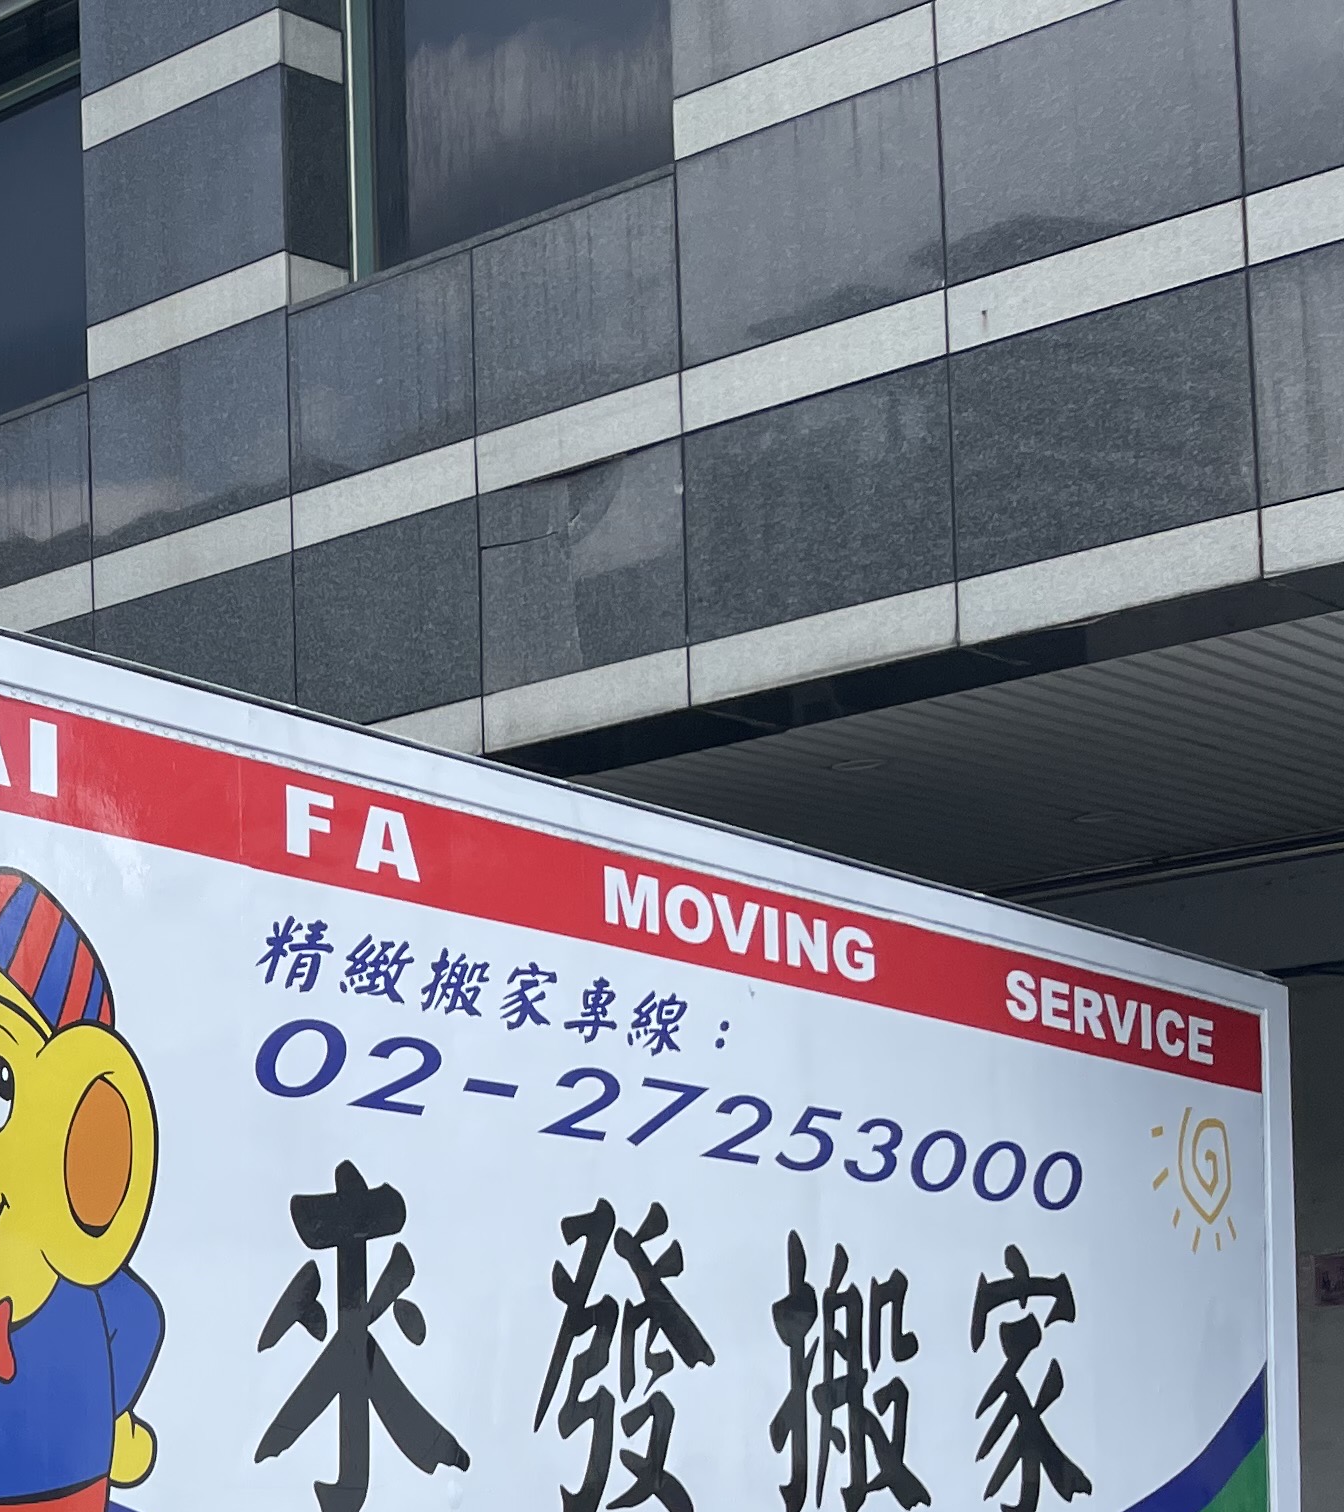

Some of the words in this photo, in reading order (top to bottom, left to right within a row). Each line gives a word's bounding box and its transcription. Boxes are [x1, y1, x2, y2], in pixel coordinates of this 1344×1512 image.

[285, 783, 421, 883] FA
[603, 865, 876, 983] MOVING
[1004, 970, 1216, 1065] SERVICE
[254, 1018, 1084, 1212] 02-27253000
